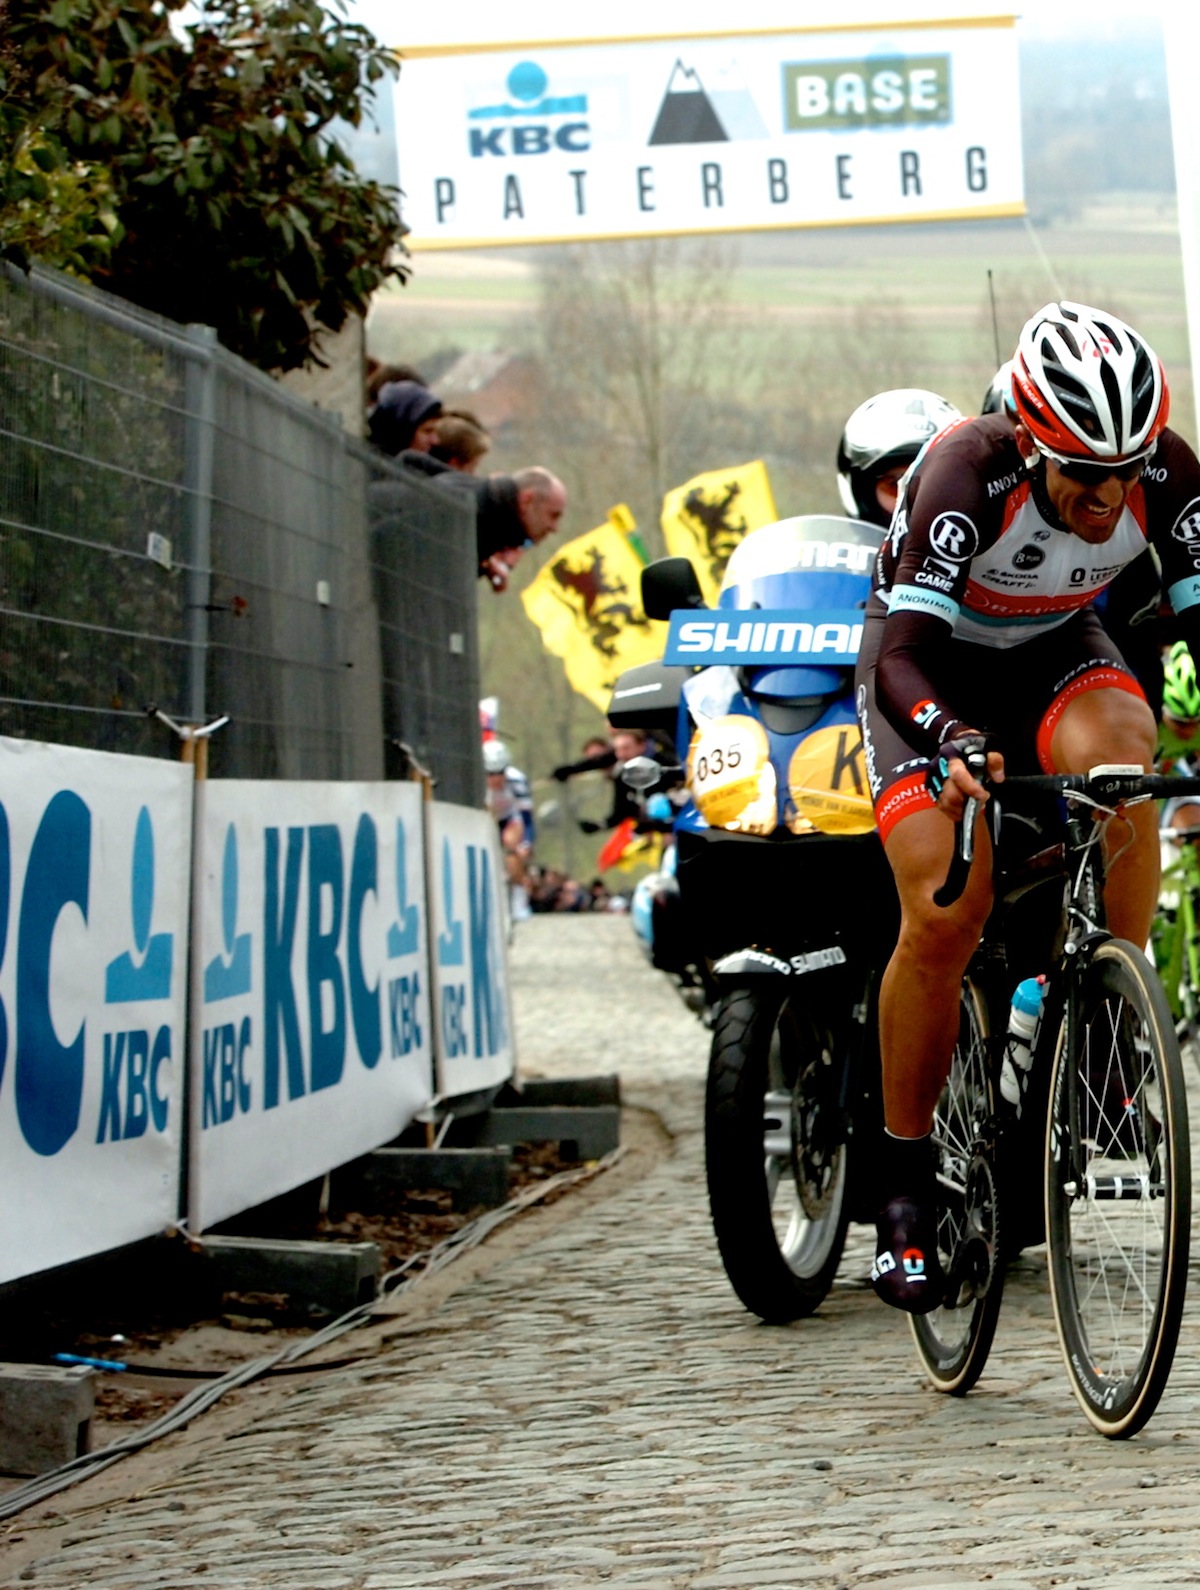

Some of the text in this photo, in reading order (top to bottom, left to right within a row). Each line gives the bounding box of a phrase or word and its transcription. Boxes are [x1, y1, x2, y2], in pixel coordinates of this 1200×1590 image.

[796, 68, 939, 118] BASE
[468, 122, 591, 158] KBC
[435, 146, 988, 224] PATERBERG
[897, 593, 952, 613] ANONIMO
[914, 571, 954, 593] CAME
[697, 743, 742, 782] 035
[831, 731, 866, 796] K
[264, 812, 383, 1112] KBC
[388, 970, 422, 1060] KBC
[96, 1024, 172, 1145] KBC
[202, 1015, 252, 1131] KBC
